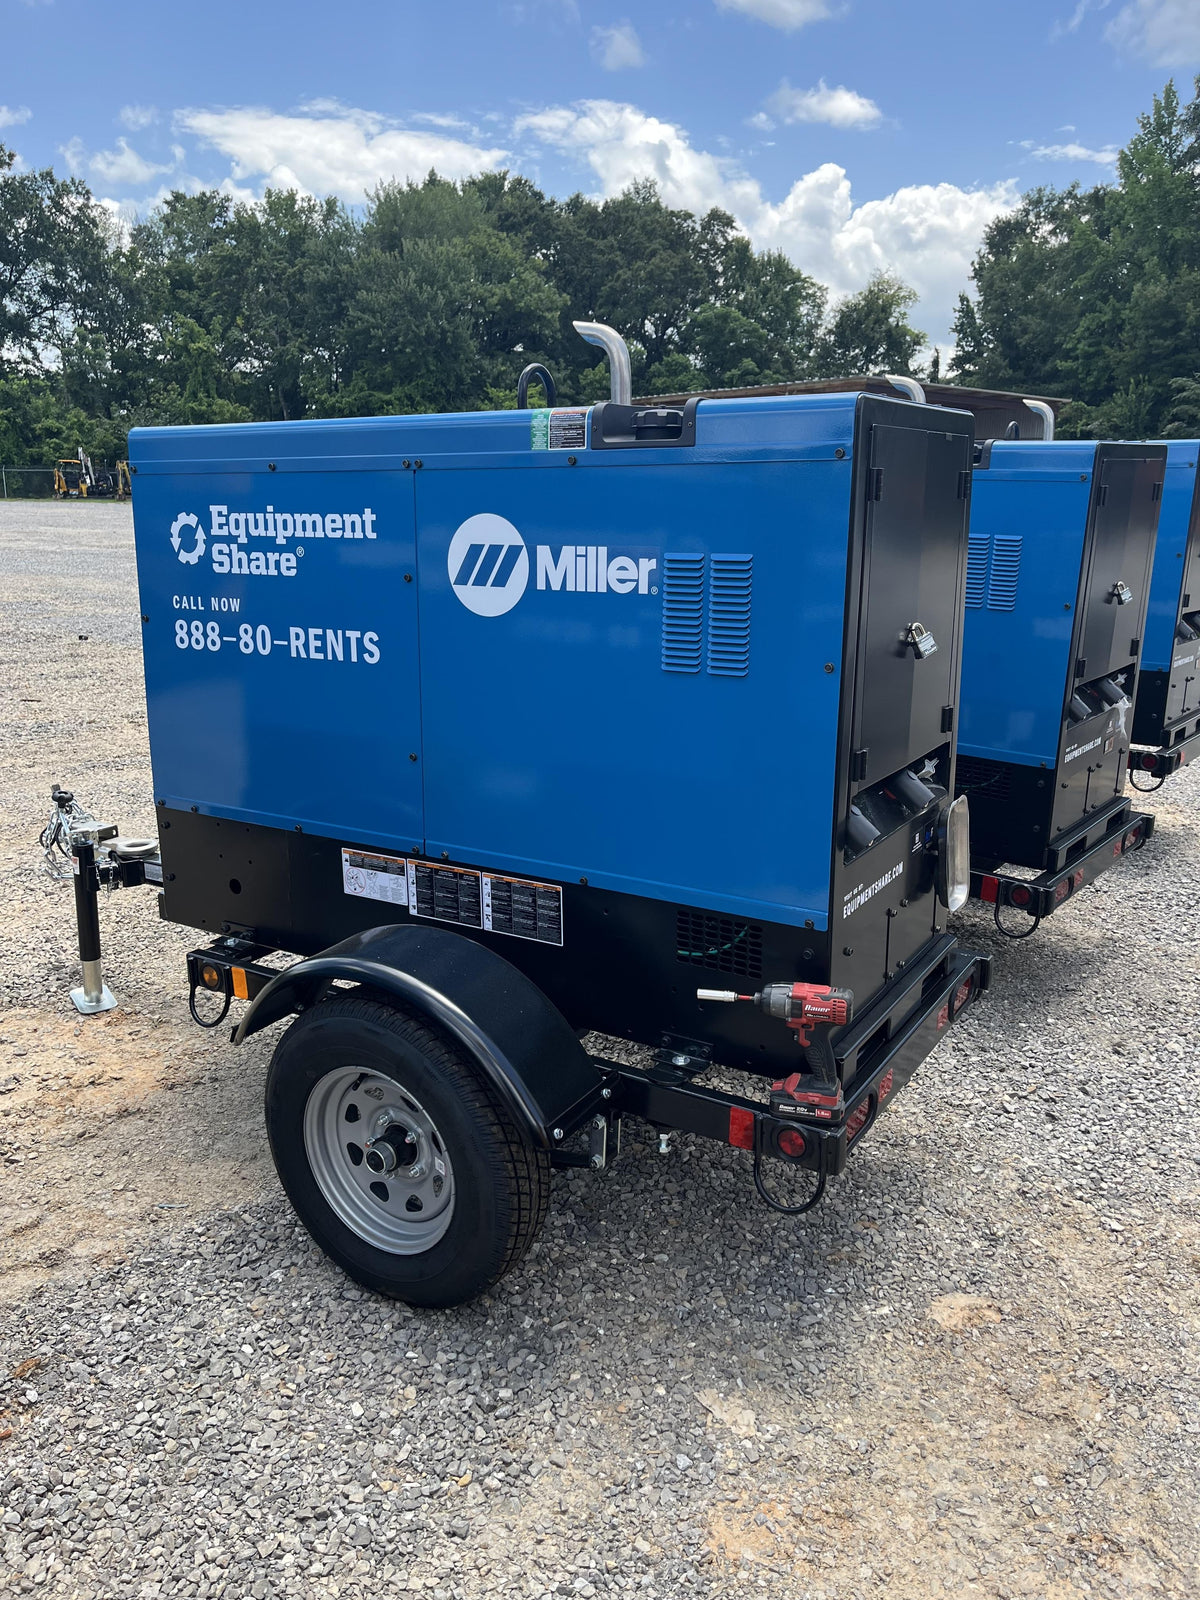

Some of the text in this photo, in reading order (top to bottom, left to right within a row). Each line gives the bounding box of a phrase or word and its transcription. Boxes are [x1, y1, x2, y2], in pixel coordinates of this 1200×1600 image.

[209, 504, 377, 544] Equipment
[172, 595, 241, 612] CALL NOW
[174, 619, 381, 664] 888-80-RENTS
[843, 861, 904, 919] EQUIPMENTSHARE.COM
[804, 1004, 831, 1013] Bauer
